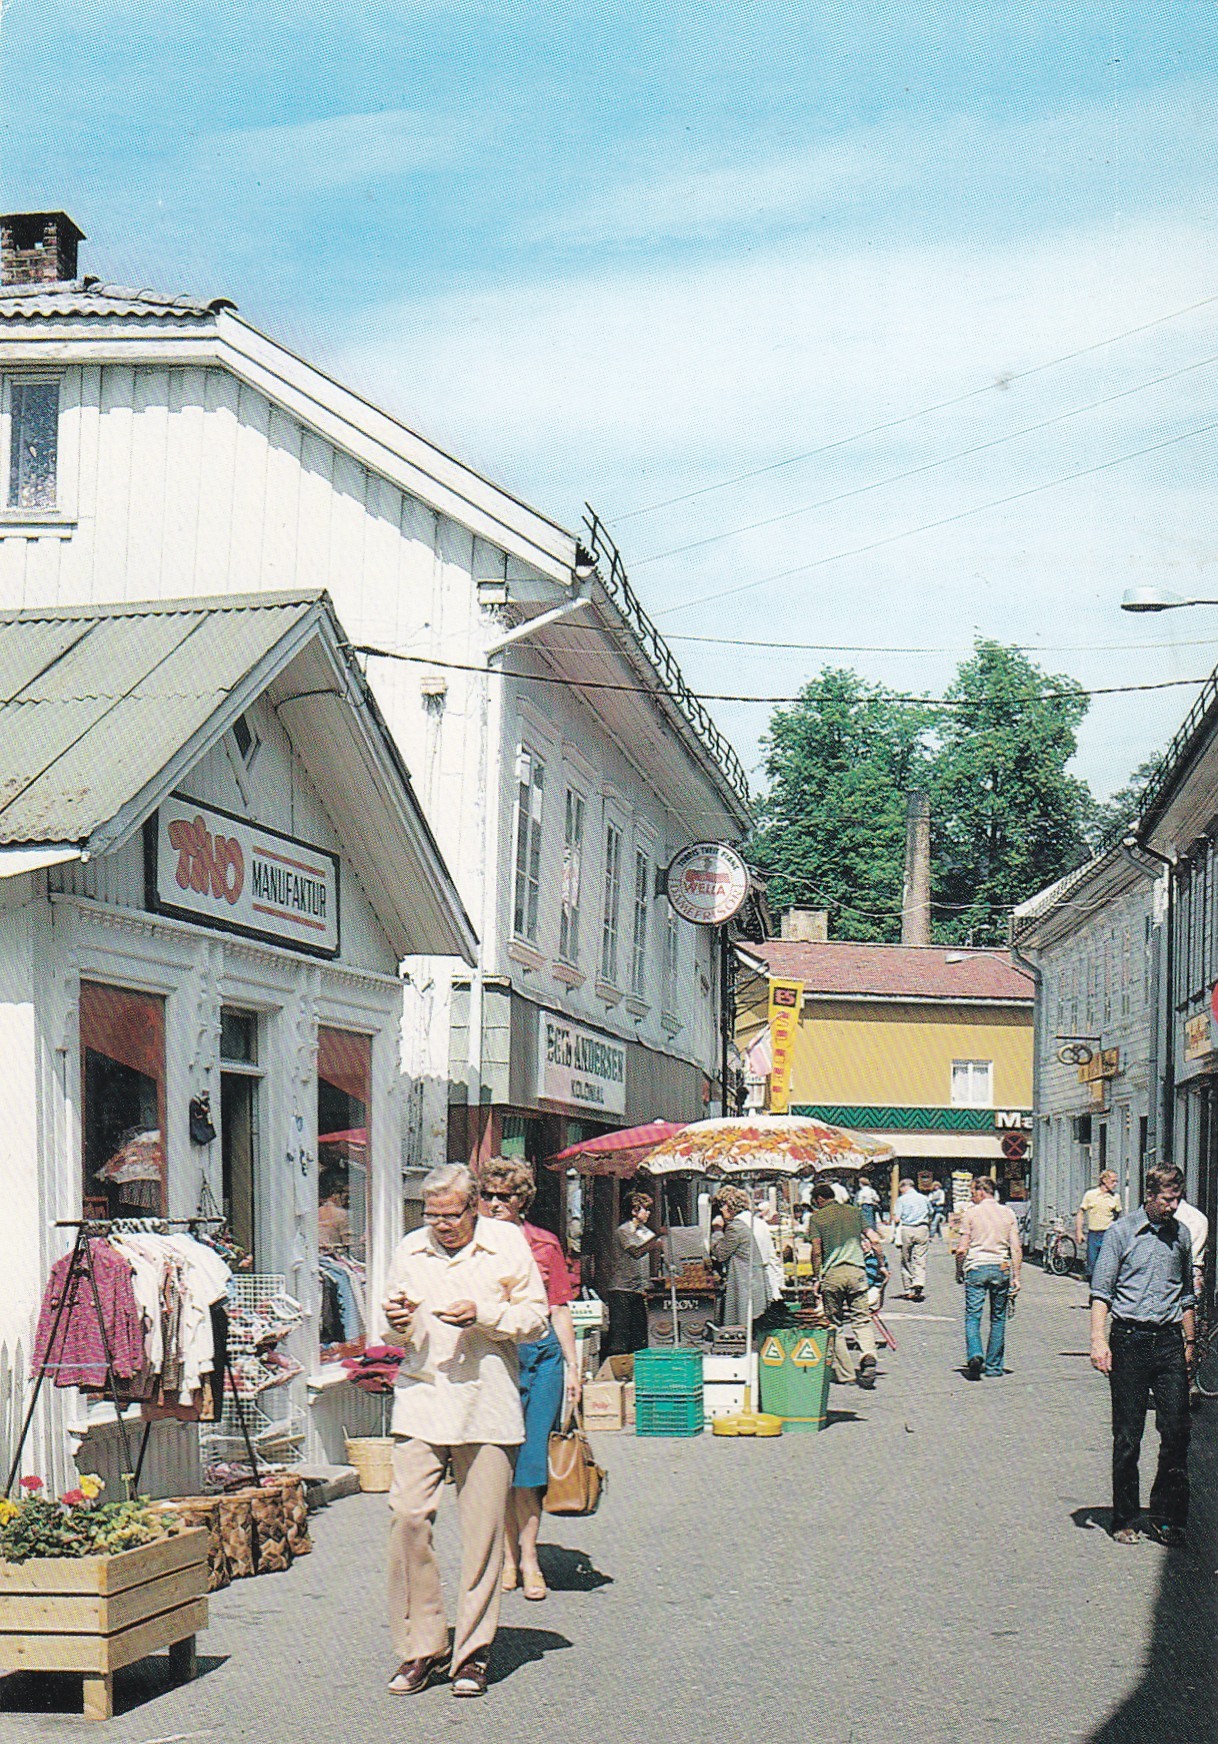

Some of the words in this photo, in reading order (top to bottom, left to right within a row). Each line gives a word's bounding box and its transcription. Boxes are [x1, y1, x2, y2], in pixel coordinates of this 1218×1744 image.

[252, 860, 326, 918] MANUFAKTUR
[684, 881, 726, 896] WELLA
[574, 1033, 624, 1083] ANDERSEN
